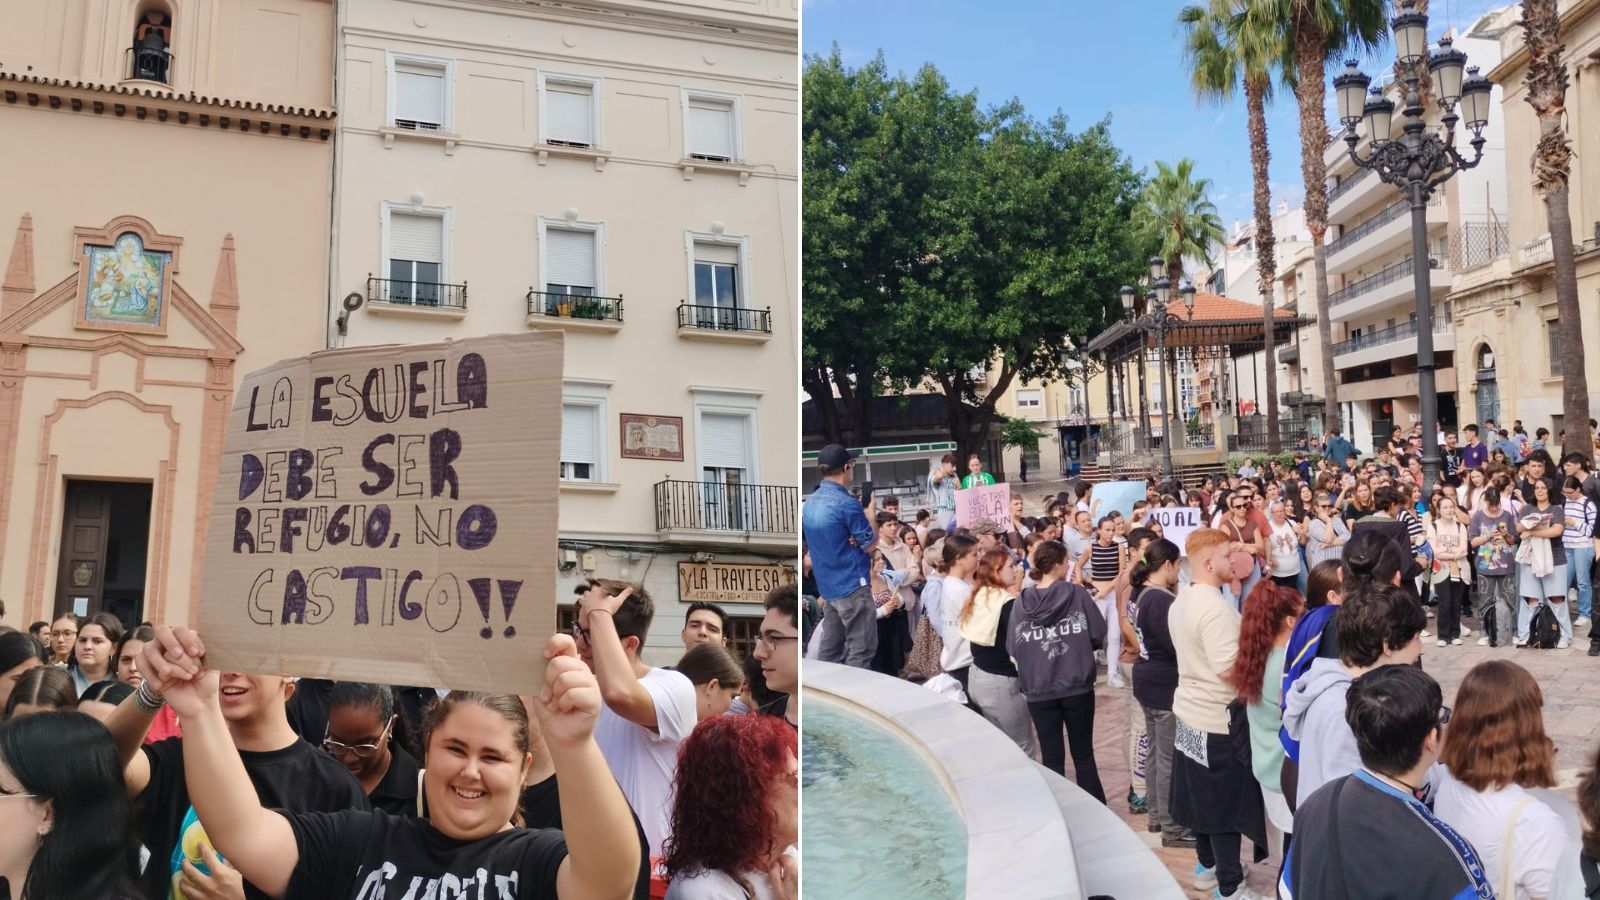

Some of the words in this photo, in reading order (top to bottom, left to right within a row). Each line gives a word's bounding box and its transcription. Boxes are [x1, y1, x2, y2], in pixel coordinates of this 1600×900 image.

[246, 377, 293, 432] LA
[312, 352, 488, 427] ESCUELA
[238, 446, 343, 503] DEBE
[359, 427, 462, 500] SER
[233, 503, 400, 554] REFUGIO,
[415, 504, 498, 551] NO
[1174, 511, 1198, 527] AL
[247, 565, 524, 640] CASTIGO!!
[693, 567, 708, 590] LA
[713, 568, 780, 592] TRAVIESA
[1022, 623, 1082, 642] YUXUS
